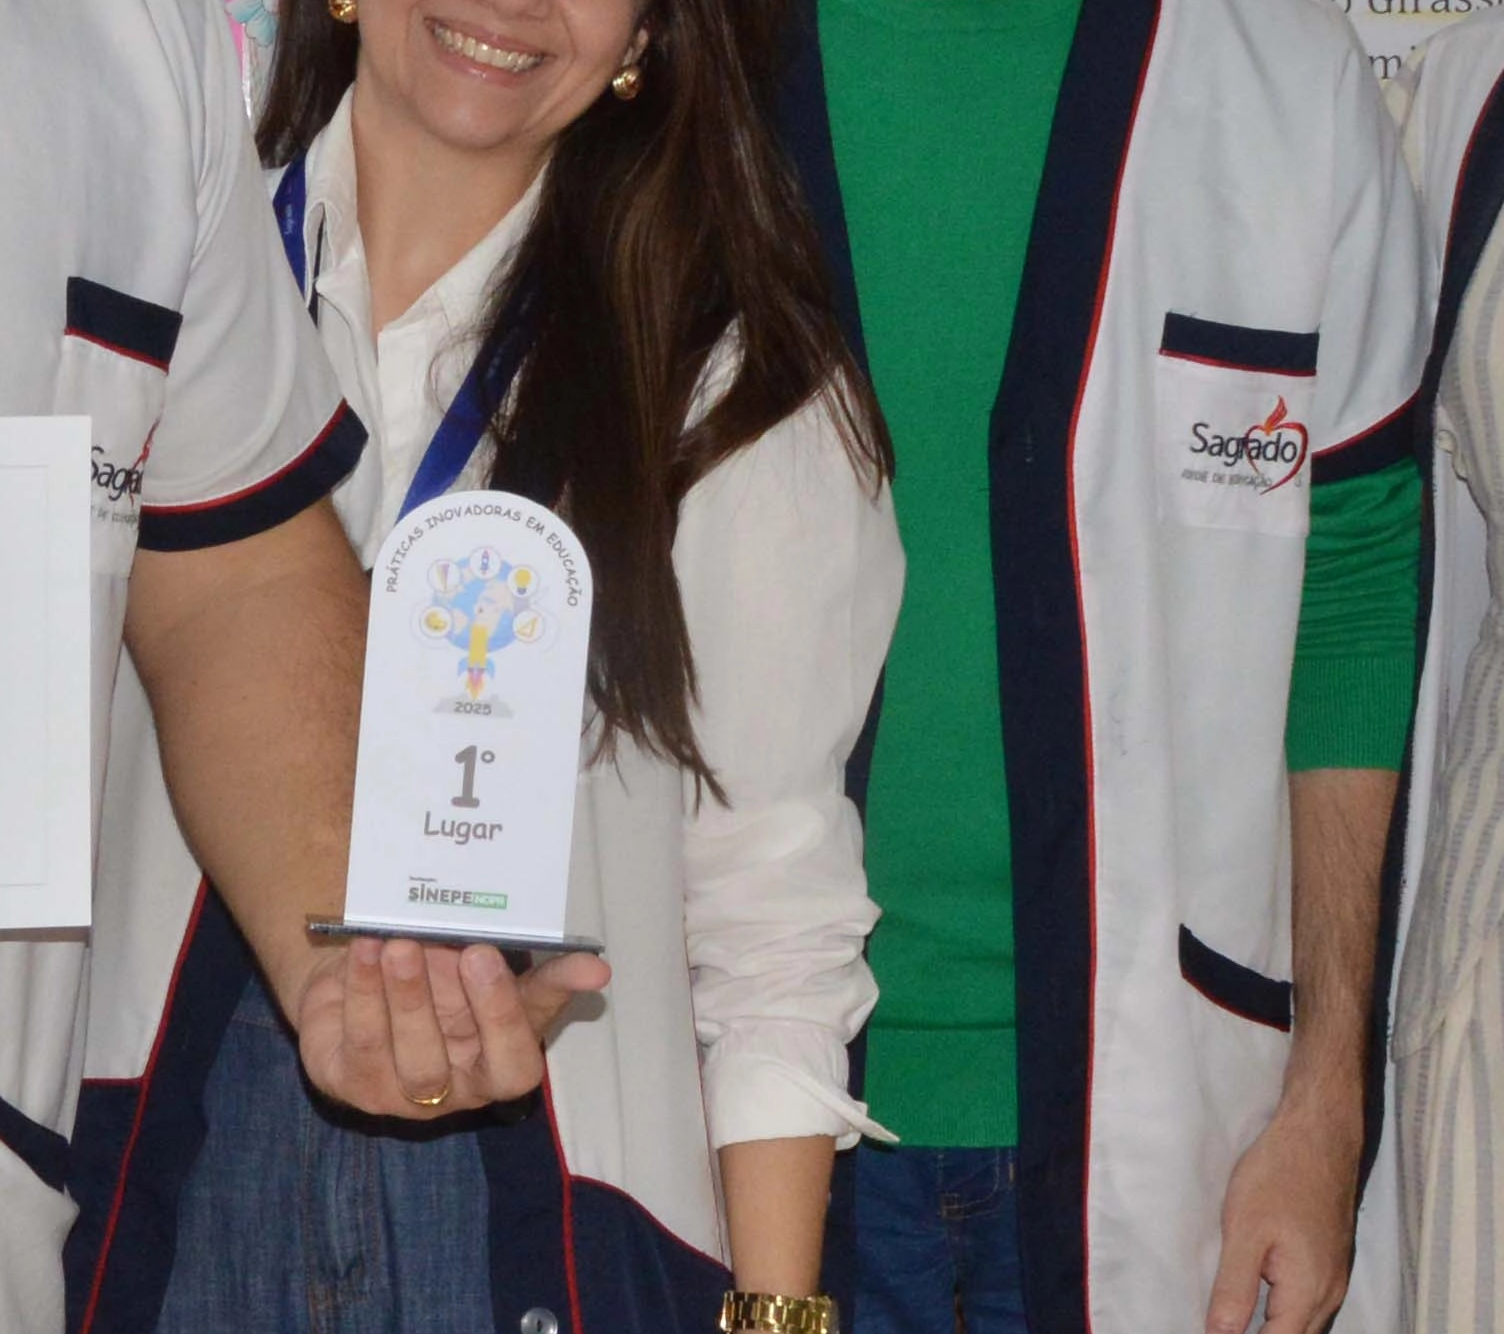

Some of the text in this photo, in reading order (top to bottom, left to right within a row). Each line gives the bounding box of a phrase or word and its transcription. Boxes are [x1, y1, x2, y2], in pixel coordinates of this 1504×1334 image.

[1189, 421, 1297, 467] Sagrado
[386, 504, 583, 607] PRÁTICAS INOVADORAS EM EDUCAÇÃO
[454, 701, 492, 716] 2025
[423, 810, 503, 846] Lugar
